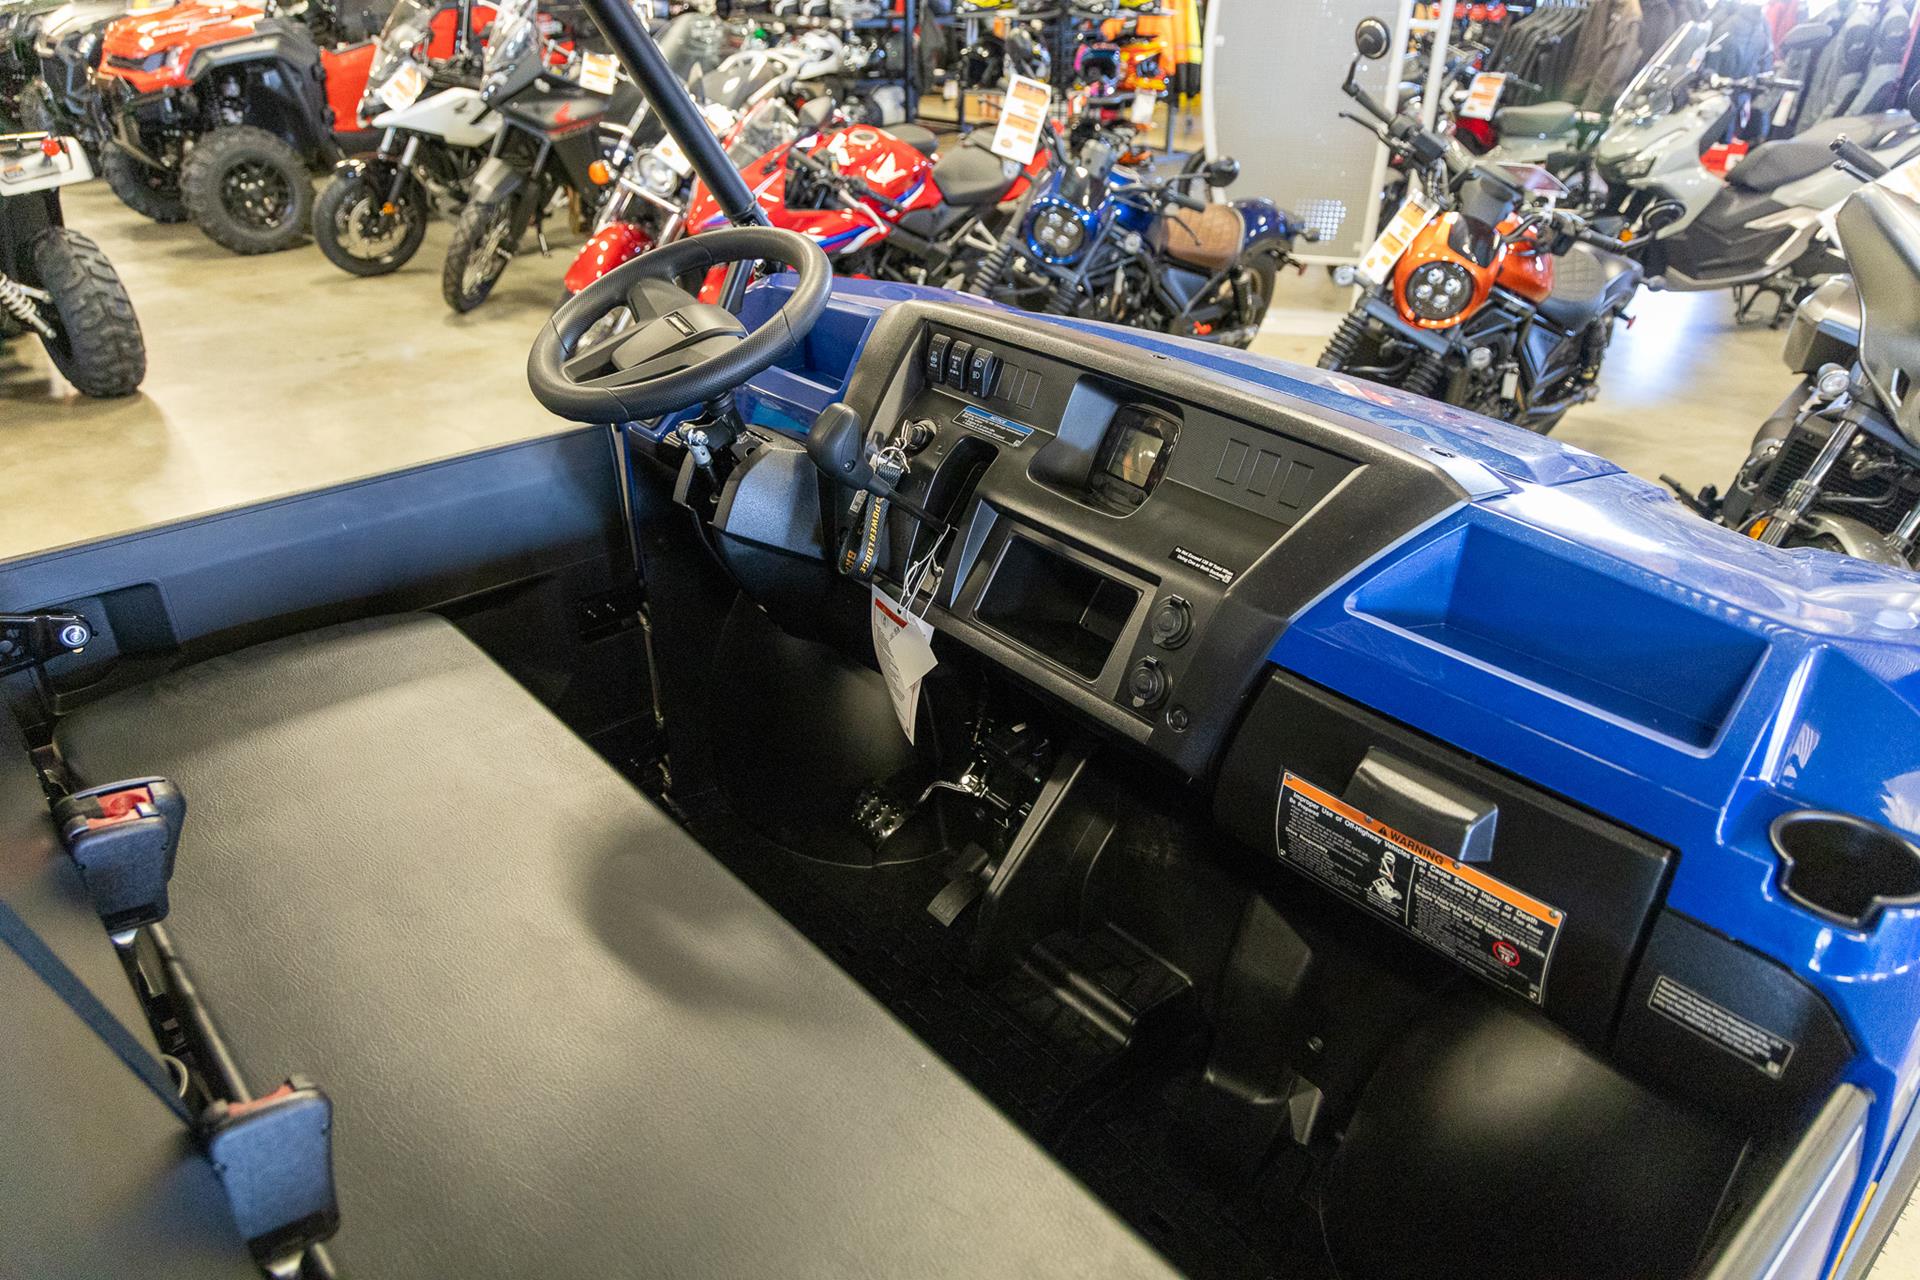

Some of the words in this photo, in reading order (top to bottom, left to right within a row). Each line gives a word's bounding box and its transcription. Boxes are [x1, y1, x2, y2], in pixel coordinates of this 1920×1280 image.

[1293, 792, 1319, 811] Improper
[1321, 807, 1333, 819] Use
[1335, 814, 1342, 823] of
[1343, 819, 1381, 845] Off-Highway
[1383, 840, 1410, 859] Vehicles
[1412, 855, 1427, 868] Can
[1429, 864, 1451, 881] Cause
[1453, 877, 1478, 895] Severe
[1480, 891, 1502, 908] Injury
[1504, 904, 1512, 913] or
[1515, 909, 1538, 926] Death
[1389, 830, 1444, 865] WARNING
